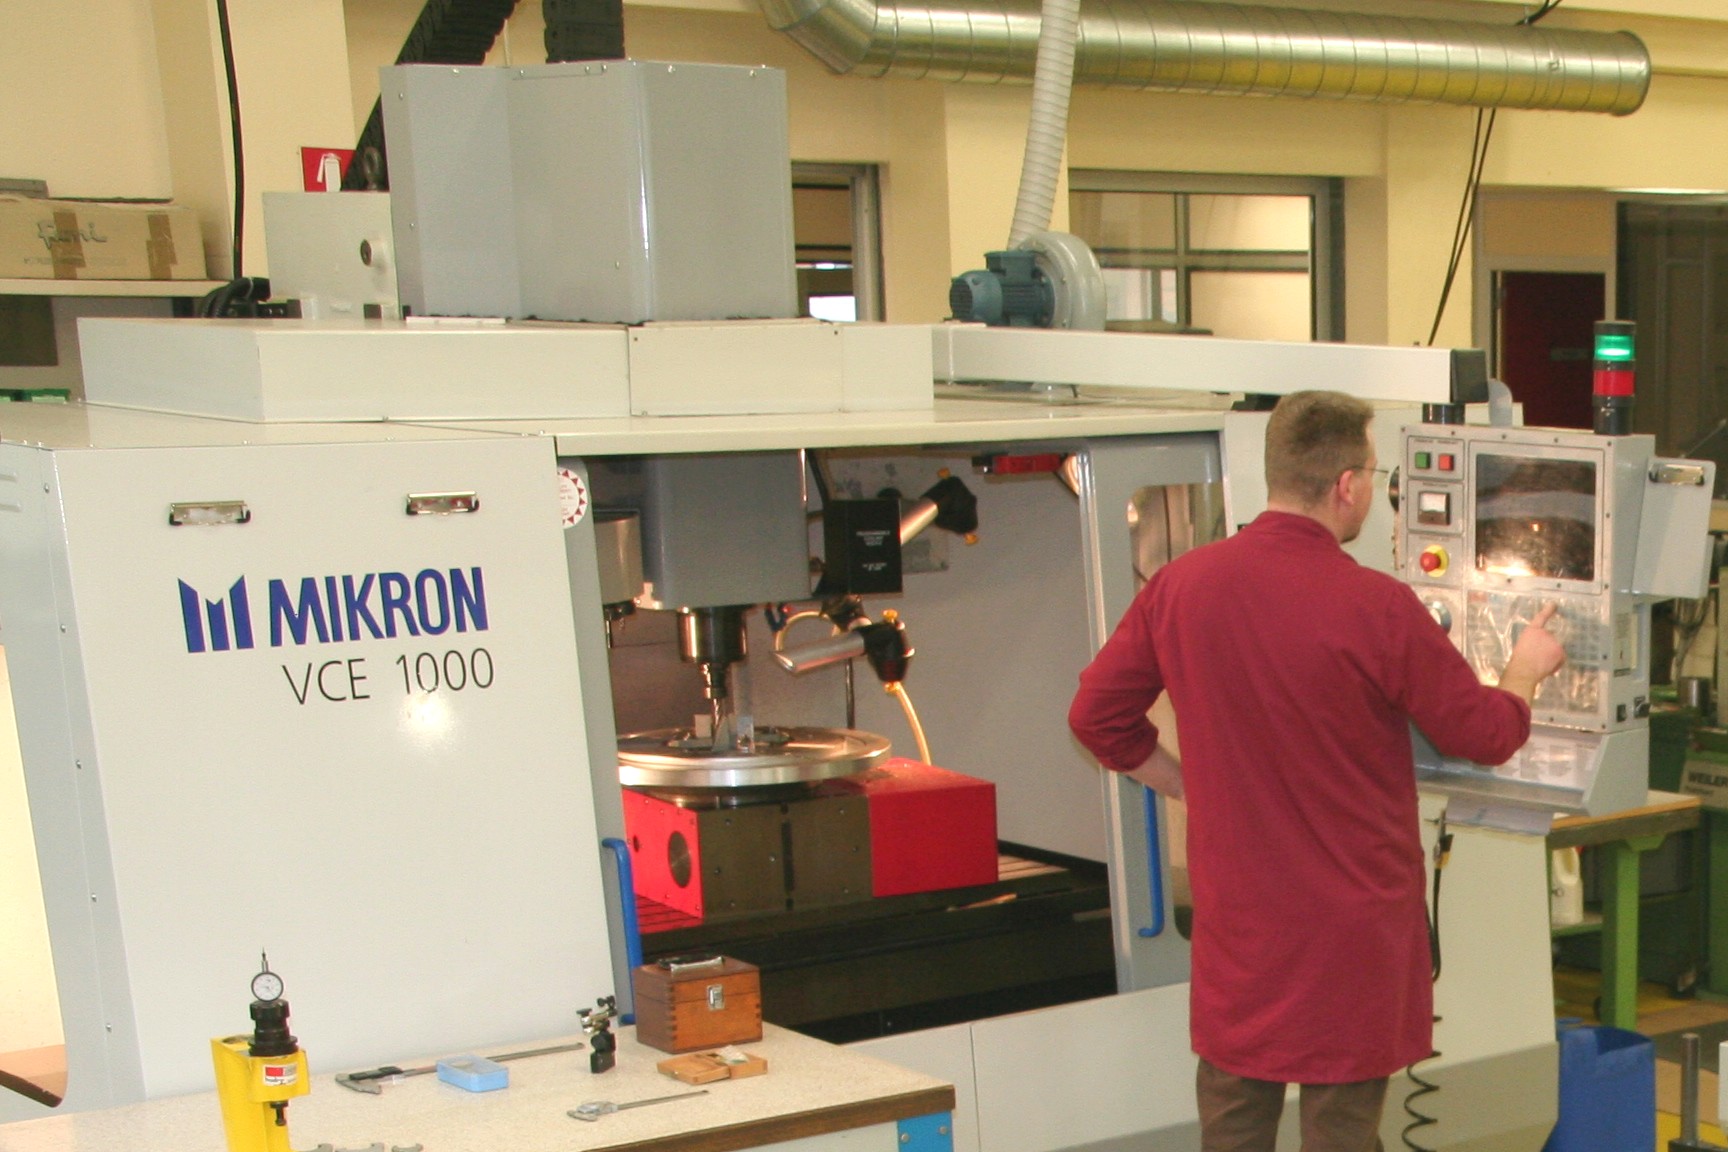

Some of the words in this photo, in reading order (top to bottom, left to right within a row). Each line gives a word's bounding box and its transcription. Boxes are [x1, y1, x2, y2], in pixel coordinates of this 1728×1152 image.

[269, 567, 489, 647] MIKRON
[282, 658, 370, 705] VCE
[396, 648, 494, 694] 1000
